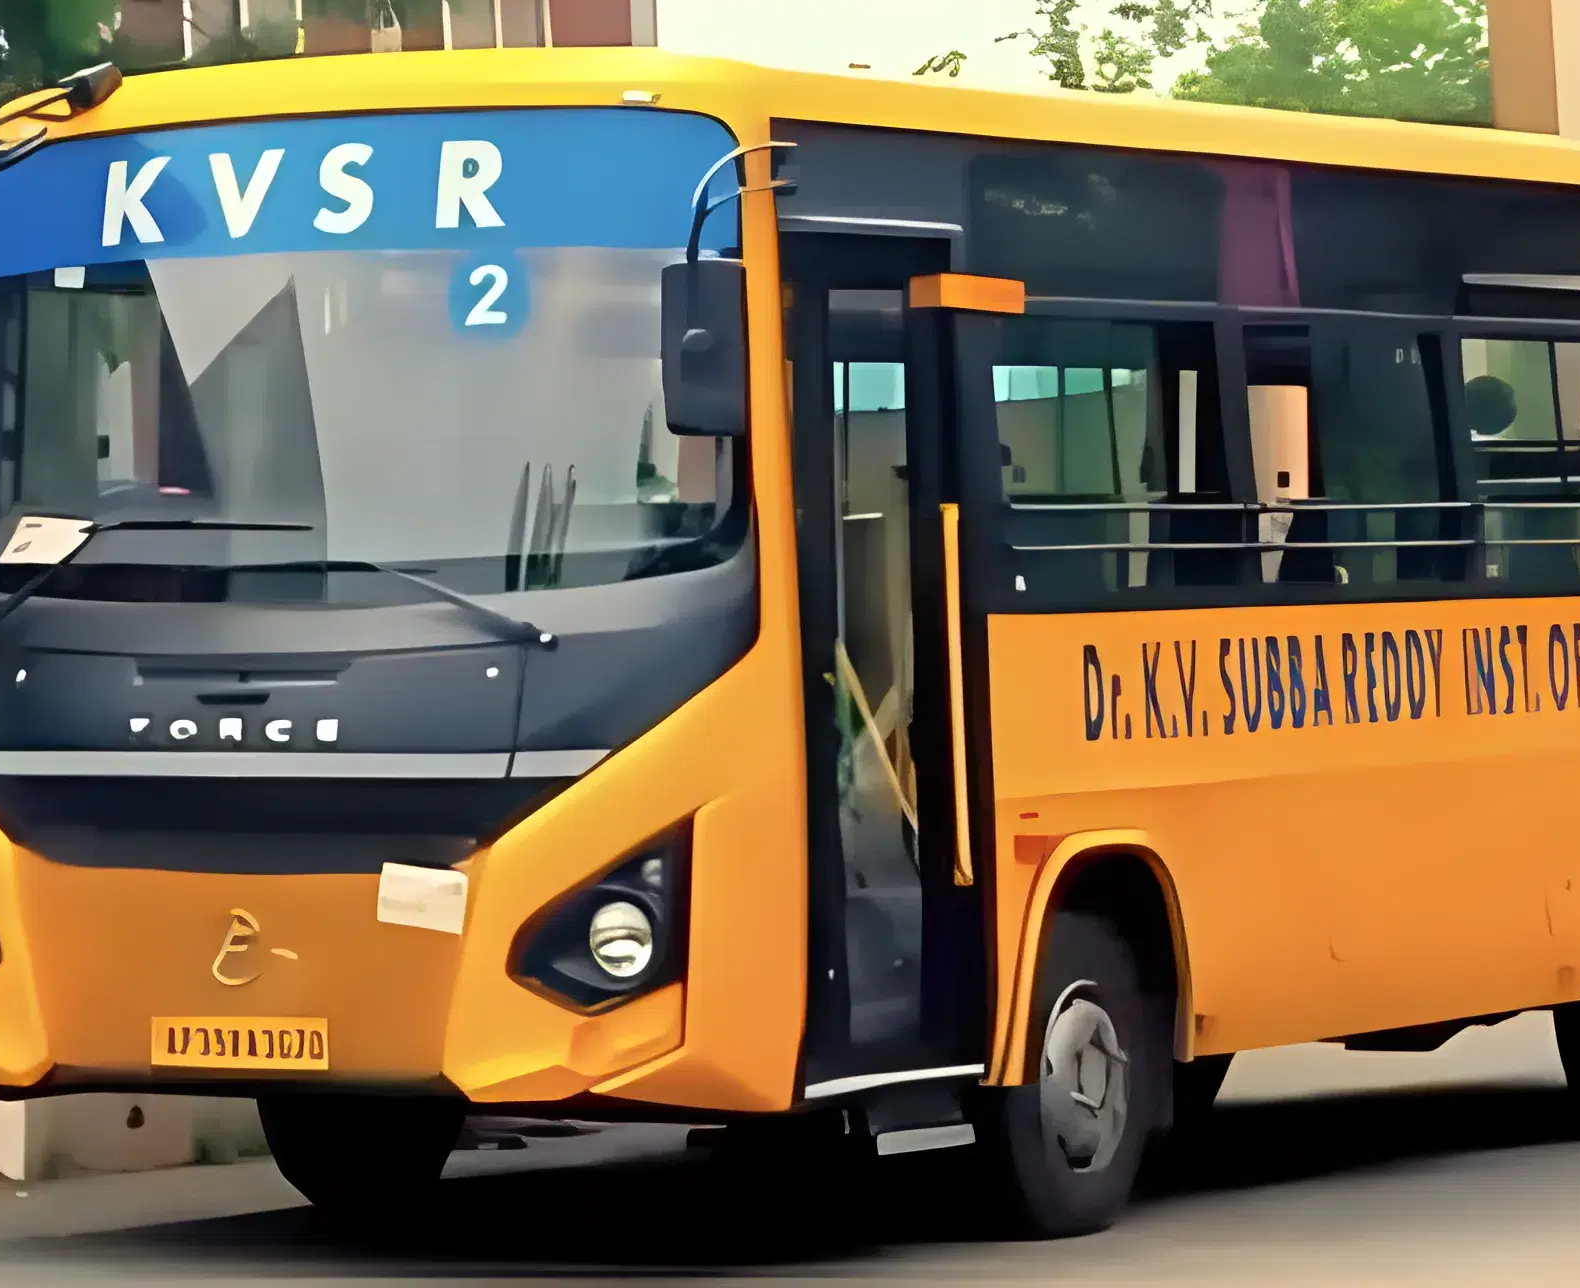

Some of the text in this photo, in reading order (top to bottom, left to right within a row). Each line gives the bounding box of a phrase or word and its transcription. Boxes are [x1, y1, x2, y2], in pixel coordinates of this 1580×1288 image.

[465, 265, 508, 326] 2
[1083, 644, 1132, 741] Dr.
[1219, 634, 1334, 735] SUBBA
[1341, 629, 1443, 724] REDDY
